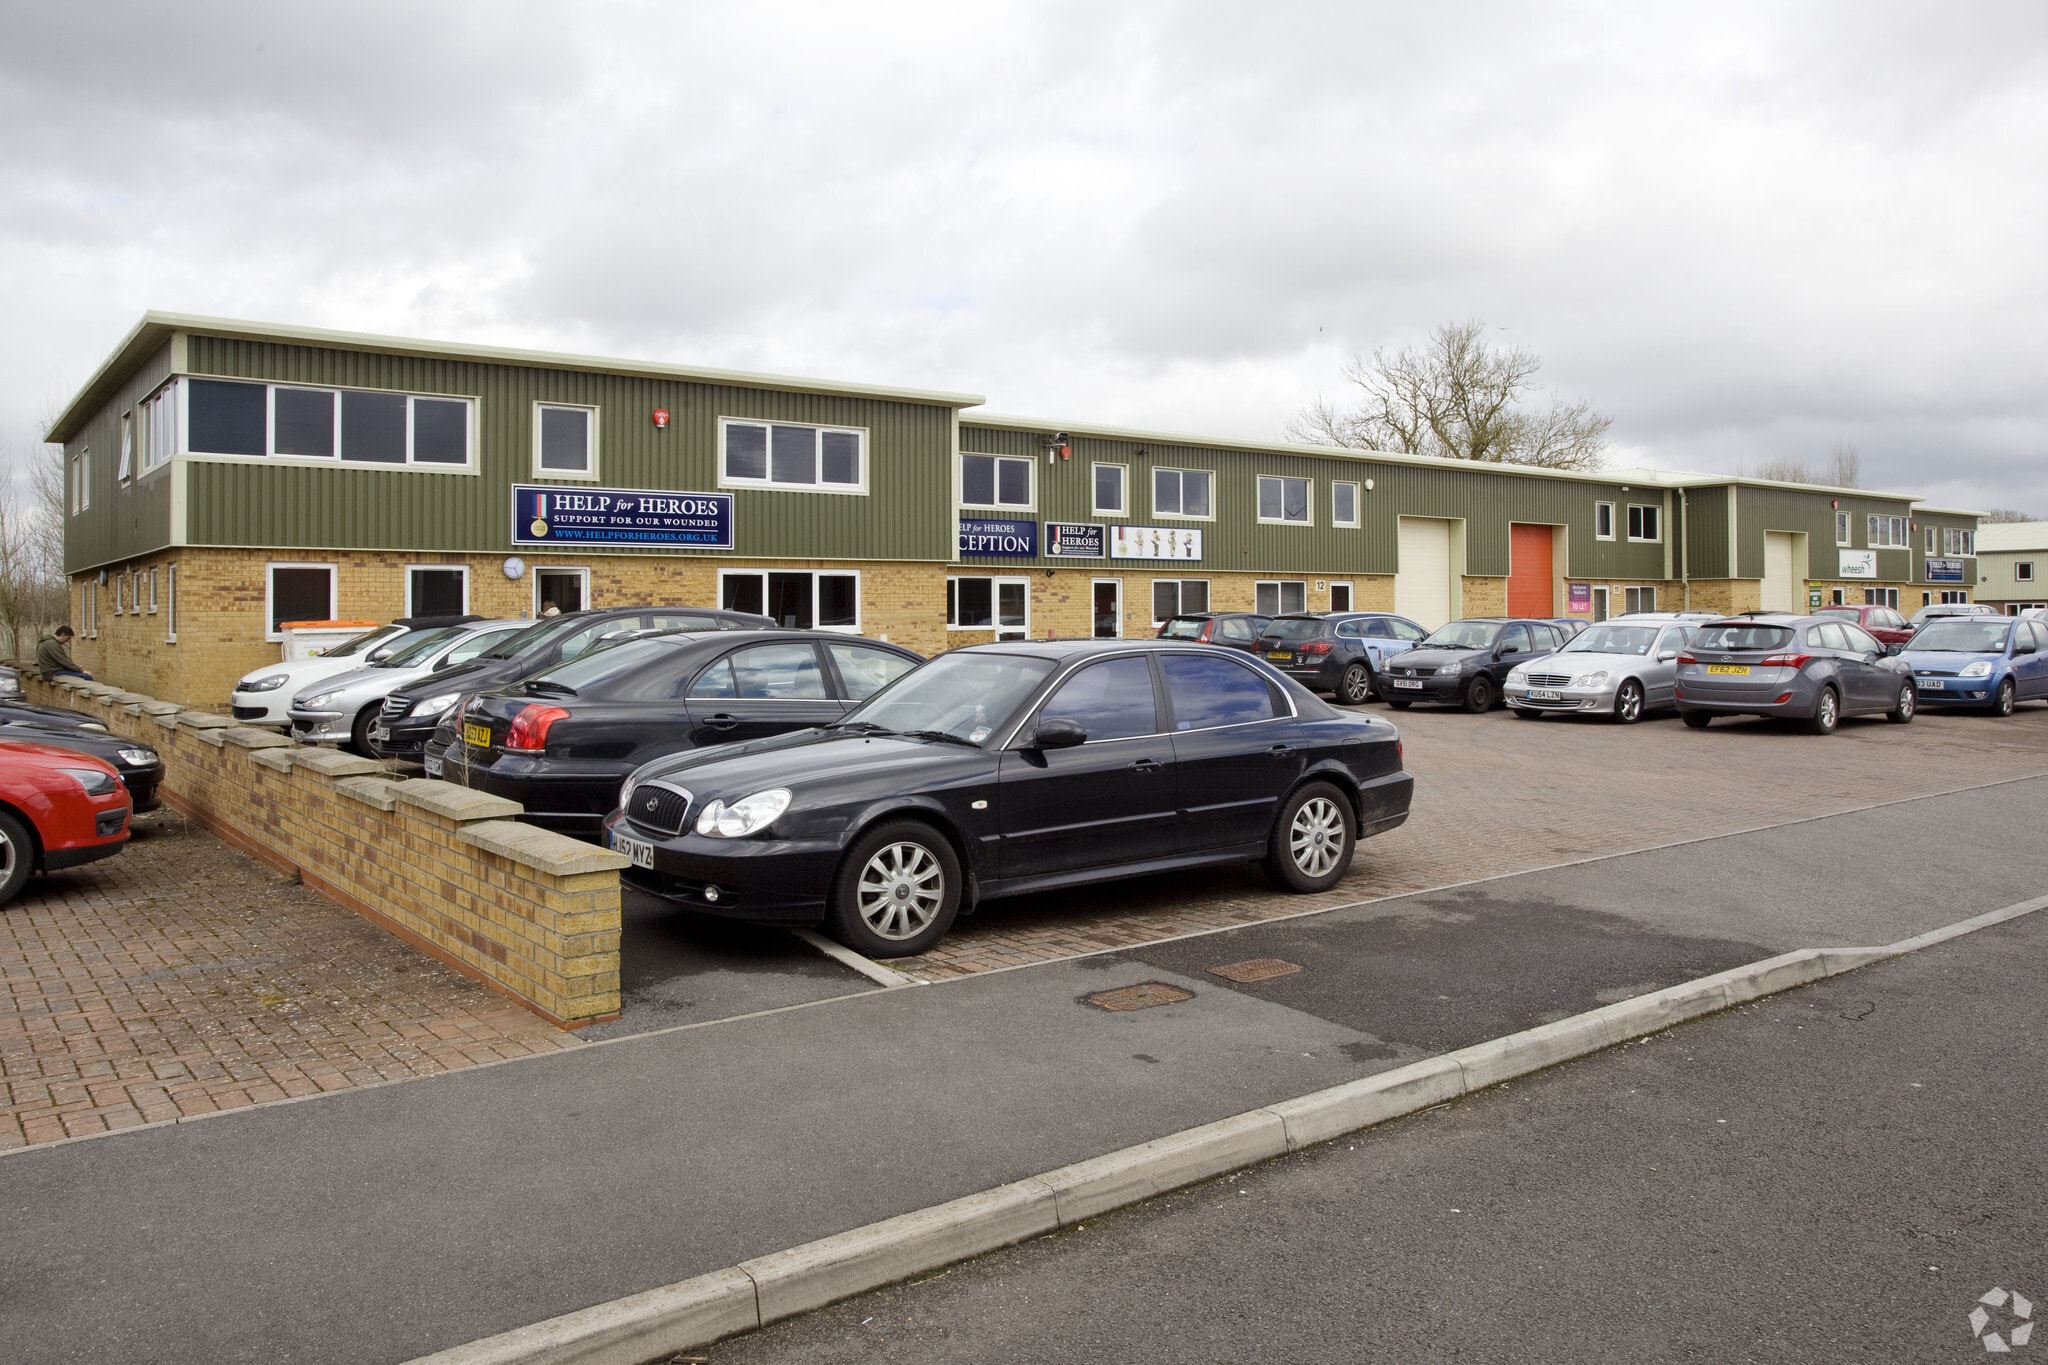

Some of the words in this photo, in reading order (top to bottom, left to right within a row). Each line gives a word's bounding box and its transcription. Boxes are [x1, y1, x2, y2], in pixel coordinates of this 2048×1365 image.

[553, 494, 611, 512] HELP
[613, 499, 634, 513] for
[638, 497, 718, 516] HEROES
[553, 514, 606, 524] SUPPORT
[610, 516, 632, 525] FOR
[636, 517, 660, 525] OUR
[663, 518, 718, 527] WOUNDED
[959, 523, 972, 532] ELP
[972, 524, 982, 534] for
[984, 524, 1015, 533] HEROES
[1062, 526, 1086, 535] HELP
[1086, 527, 1098, 537] for
[555, 530, 718, 542] WWW.HELPFORHEROES.ORG.UK
[1062, 537, 1099, 546] HEROES
[959, 534, 1030, 552] CEPTION
[1842, 564, 1864, 574] wheesh
[1317, 581, 1325, 590] 12
[1731, 666, 1747, 674] JZH
[632, 842, 652, 866] MYZ
